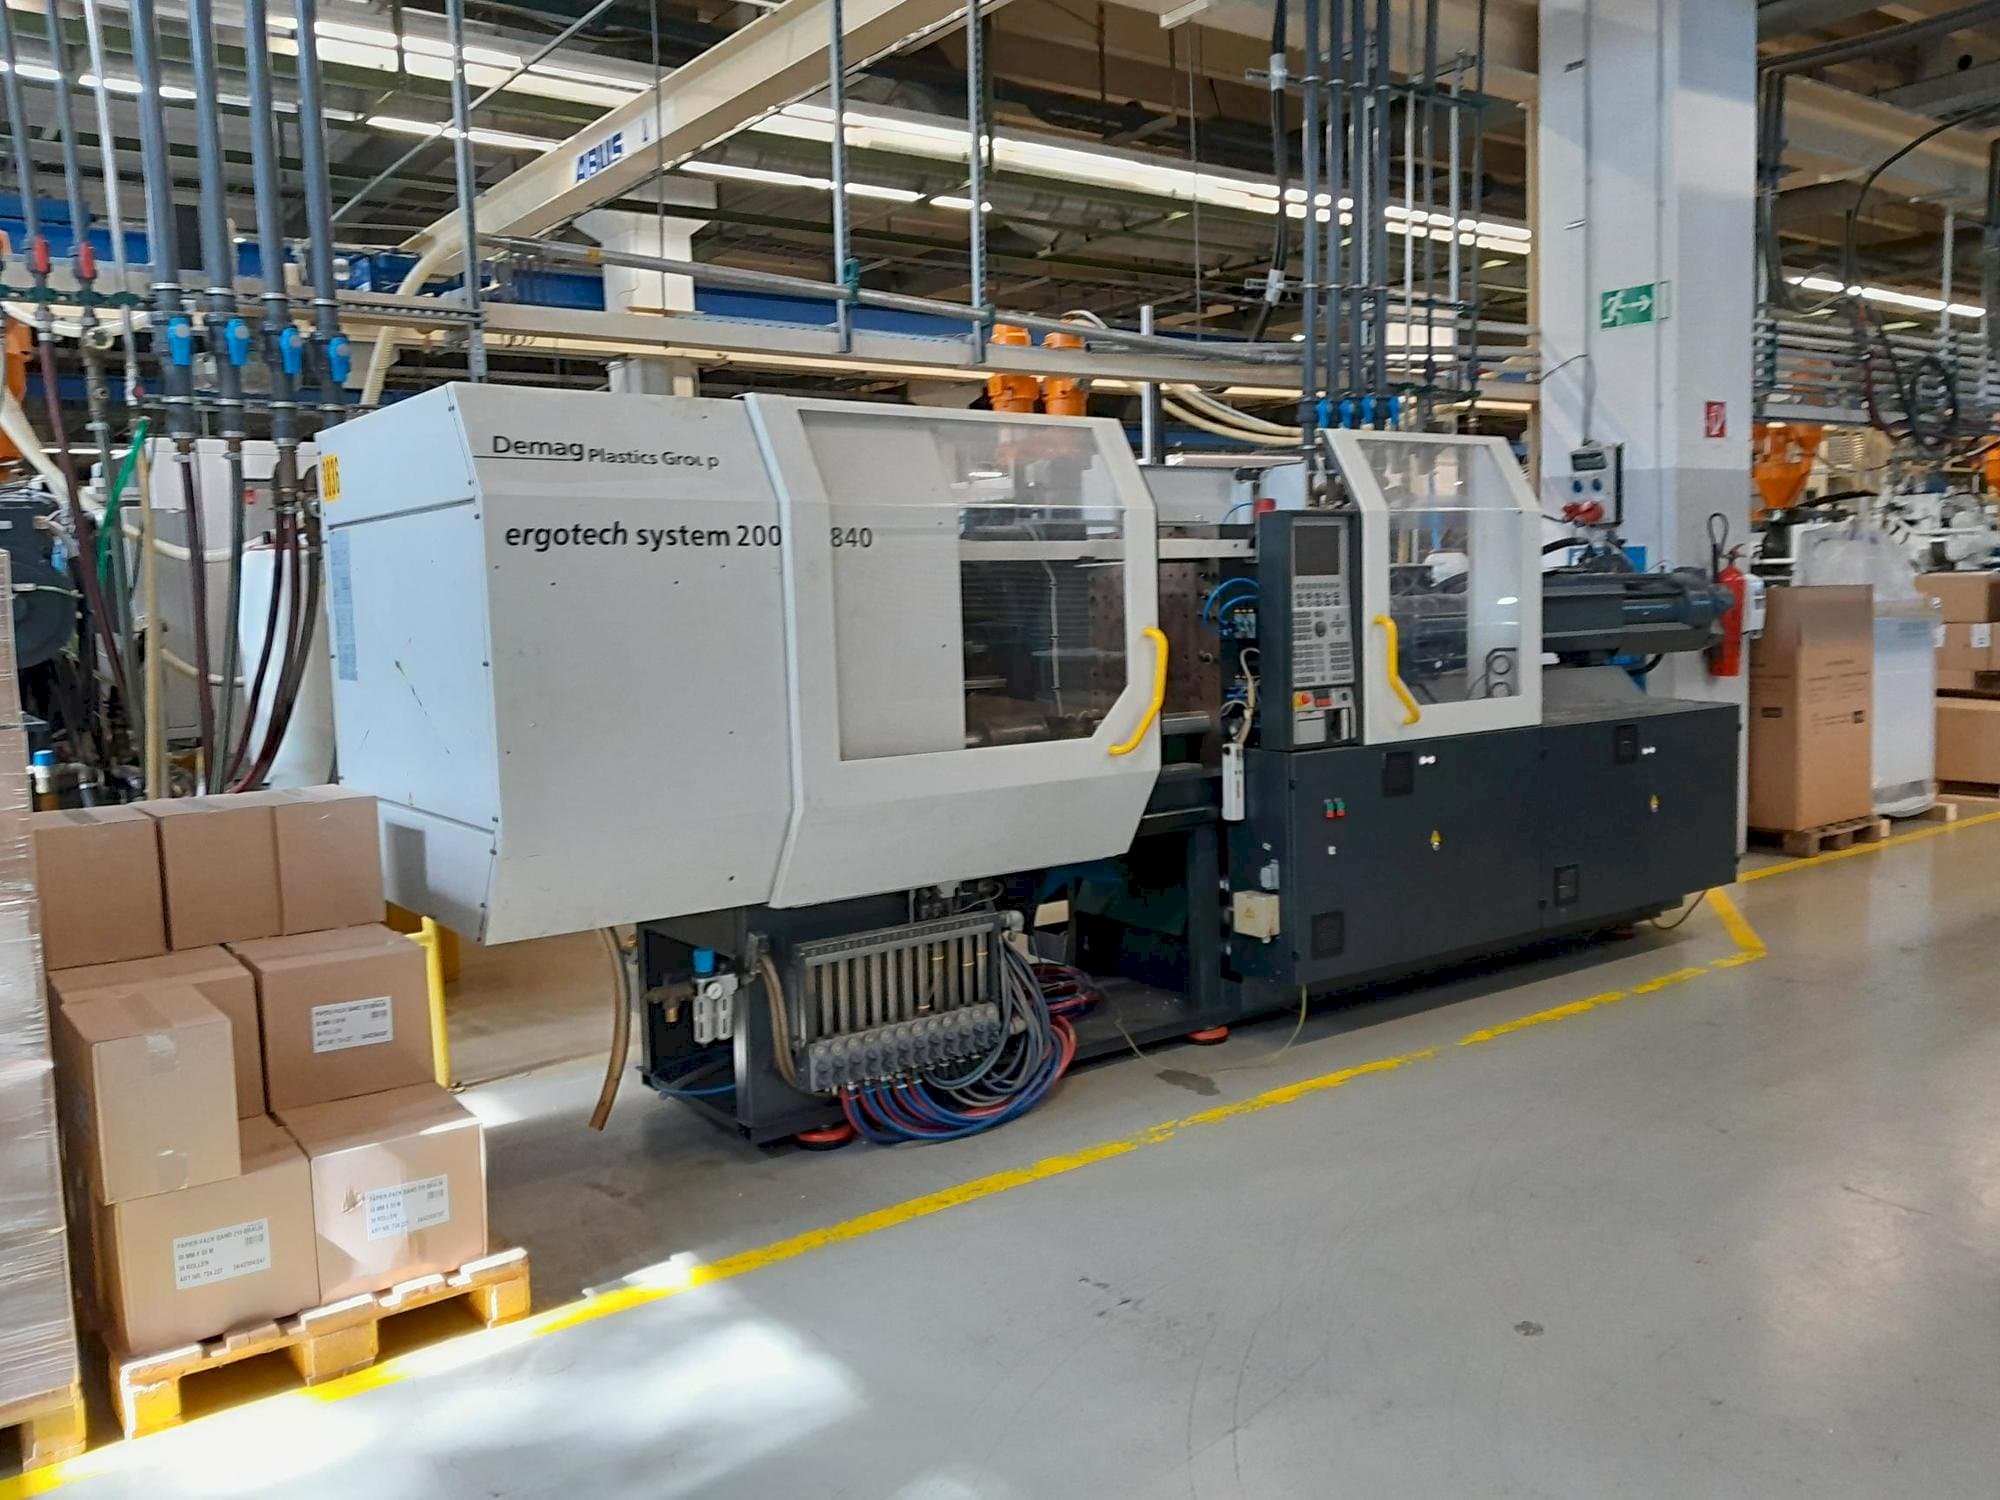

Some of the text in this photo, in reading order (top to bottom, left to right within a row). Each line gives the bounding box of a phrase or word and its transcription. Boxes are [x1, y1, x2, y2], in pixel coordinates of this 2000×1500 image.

[493, 436, 583, 461] Demag
[588, 448, 658, 464] Plastics
[505, 521, 872, 552] ergotech system 200 840
